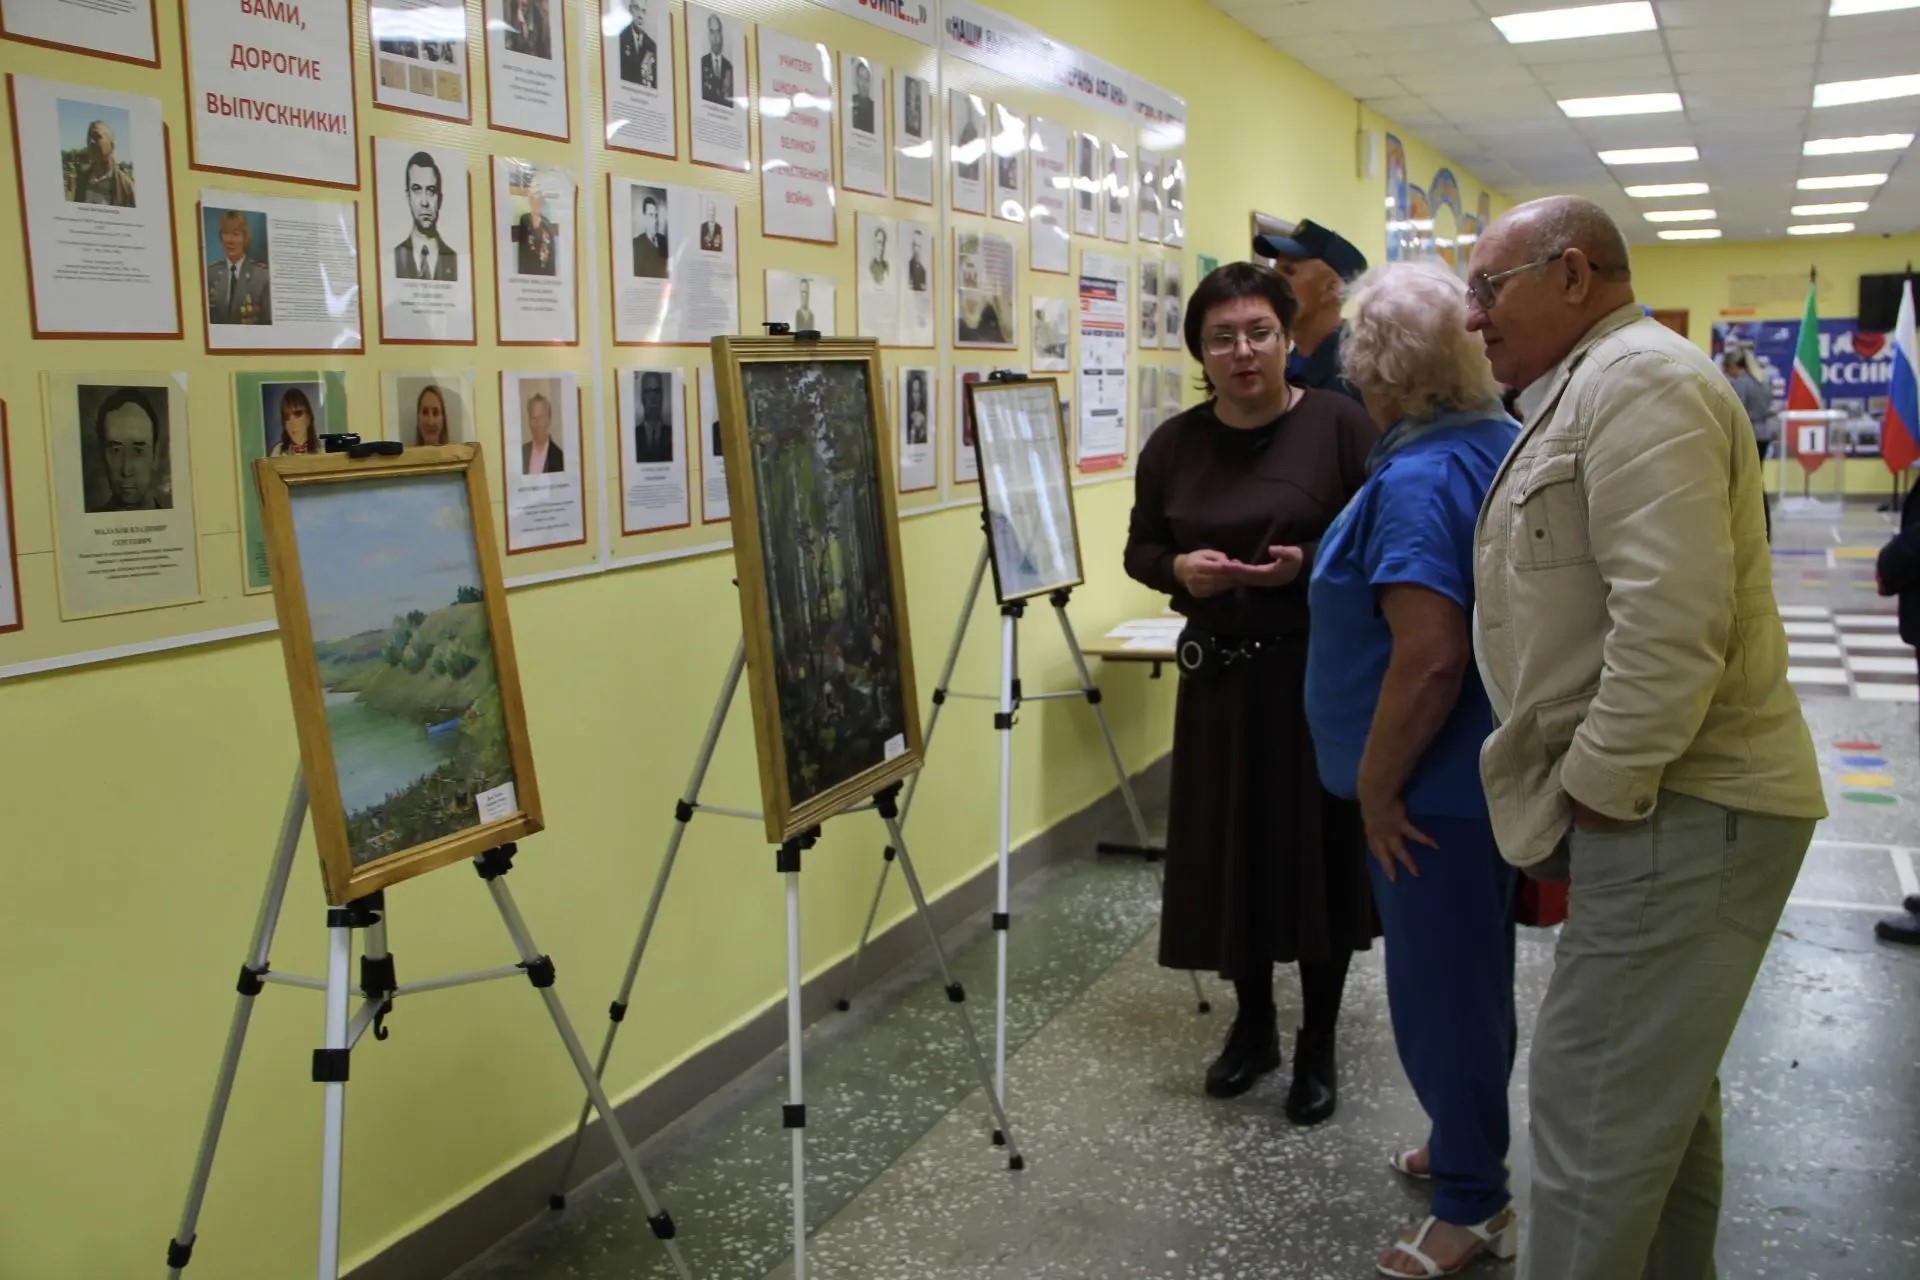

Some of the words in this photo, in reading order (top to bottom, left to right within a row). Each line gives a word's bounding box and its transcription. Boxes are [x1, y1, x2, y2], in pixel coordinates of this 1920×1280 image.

[240, 0, 306, 30] ВАМИ,
[230, 44, 321, 81] ДОРОГИЕ
[206, 92, 348, 135] ВЫПУСКНИКИ!
[768, 164, 829, 182] ТЕЧЕСТВЕННОЙ
